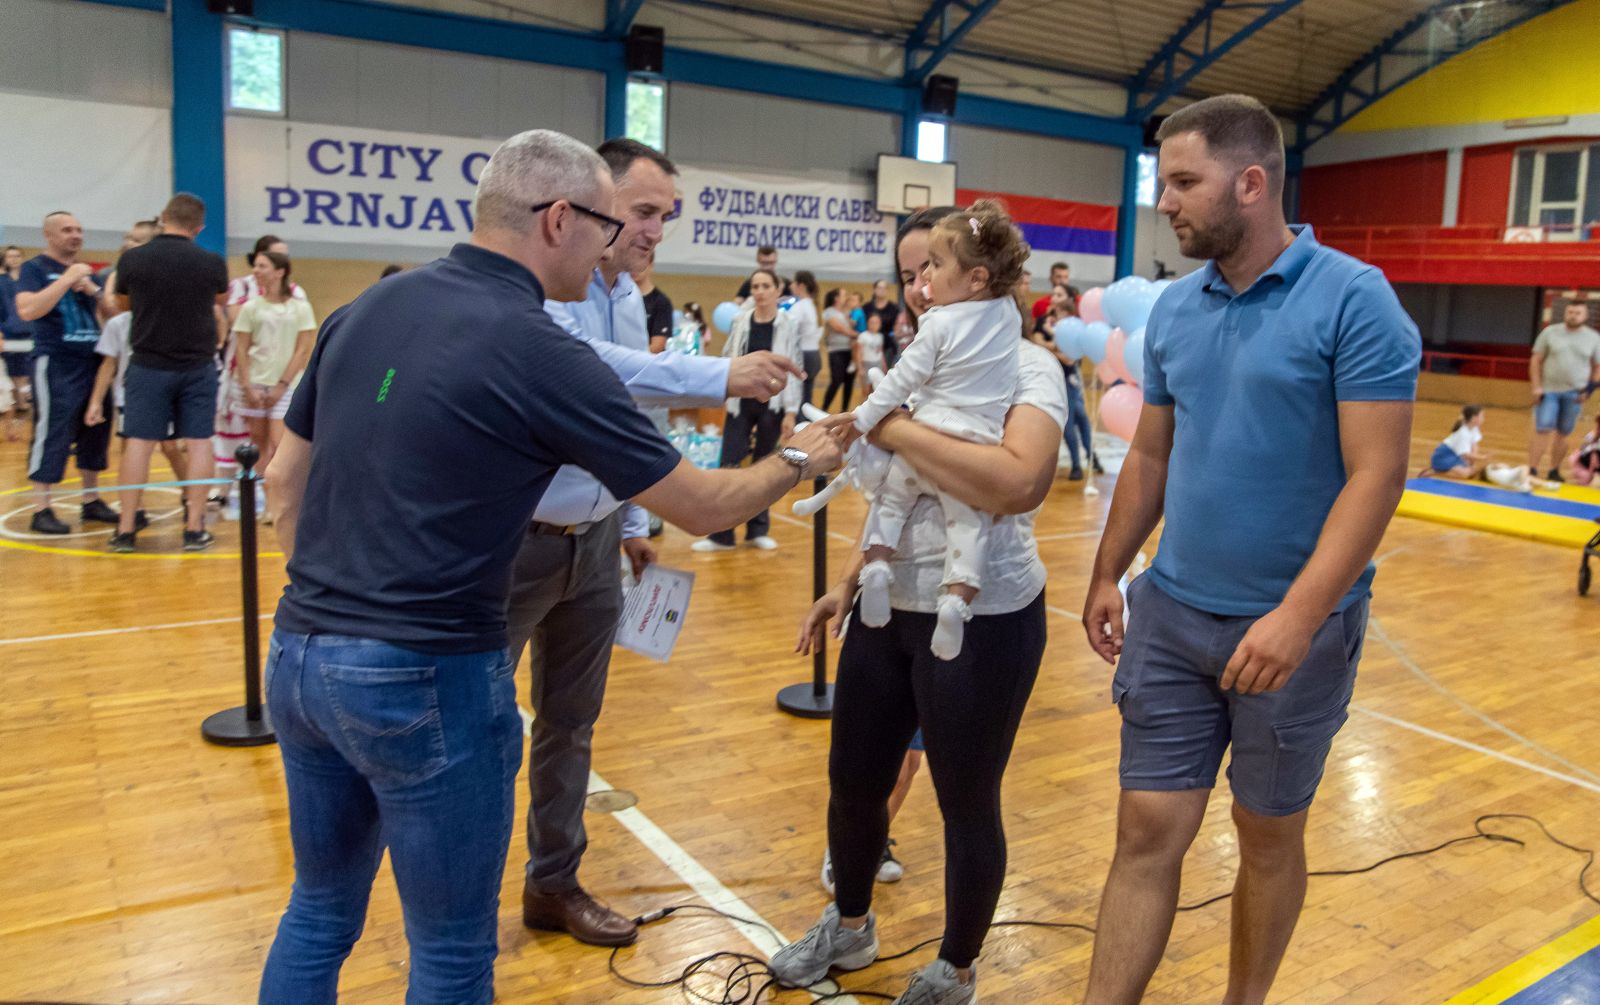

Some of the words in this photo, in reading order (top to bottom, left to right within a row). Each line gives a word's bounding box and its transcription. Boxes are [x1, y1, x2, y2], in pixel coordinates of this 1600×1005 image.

[307, 138, 442, 182] CITY
[264, 186, 475, 233] PRNJAV
[698, 186, 820, 219] ФУДБАЛСКИ
[692, 219, 809, 251] РЕПУБЛИКЕ
[815, 228, 887, 254] СРПСКЕ
